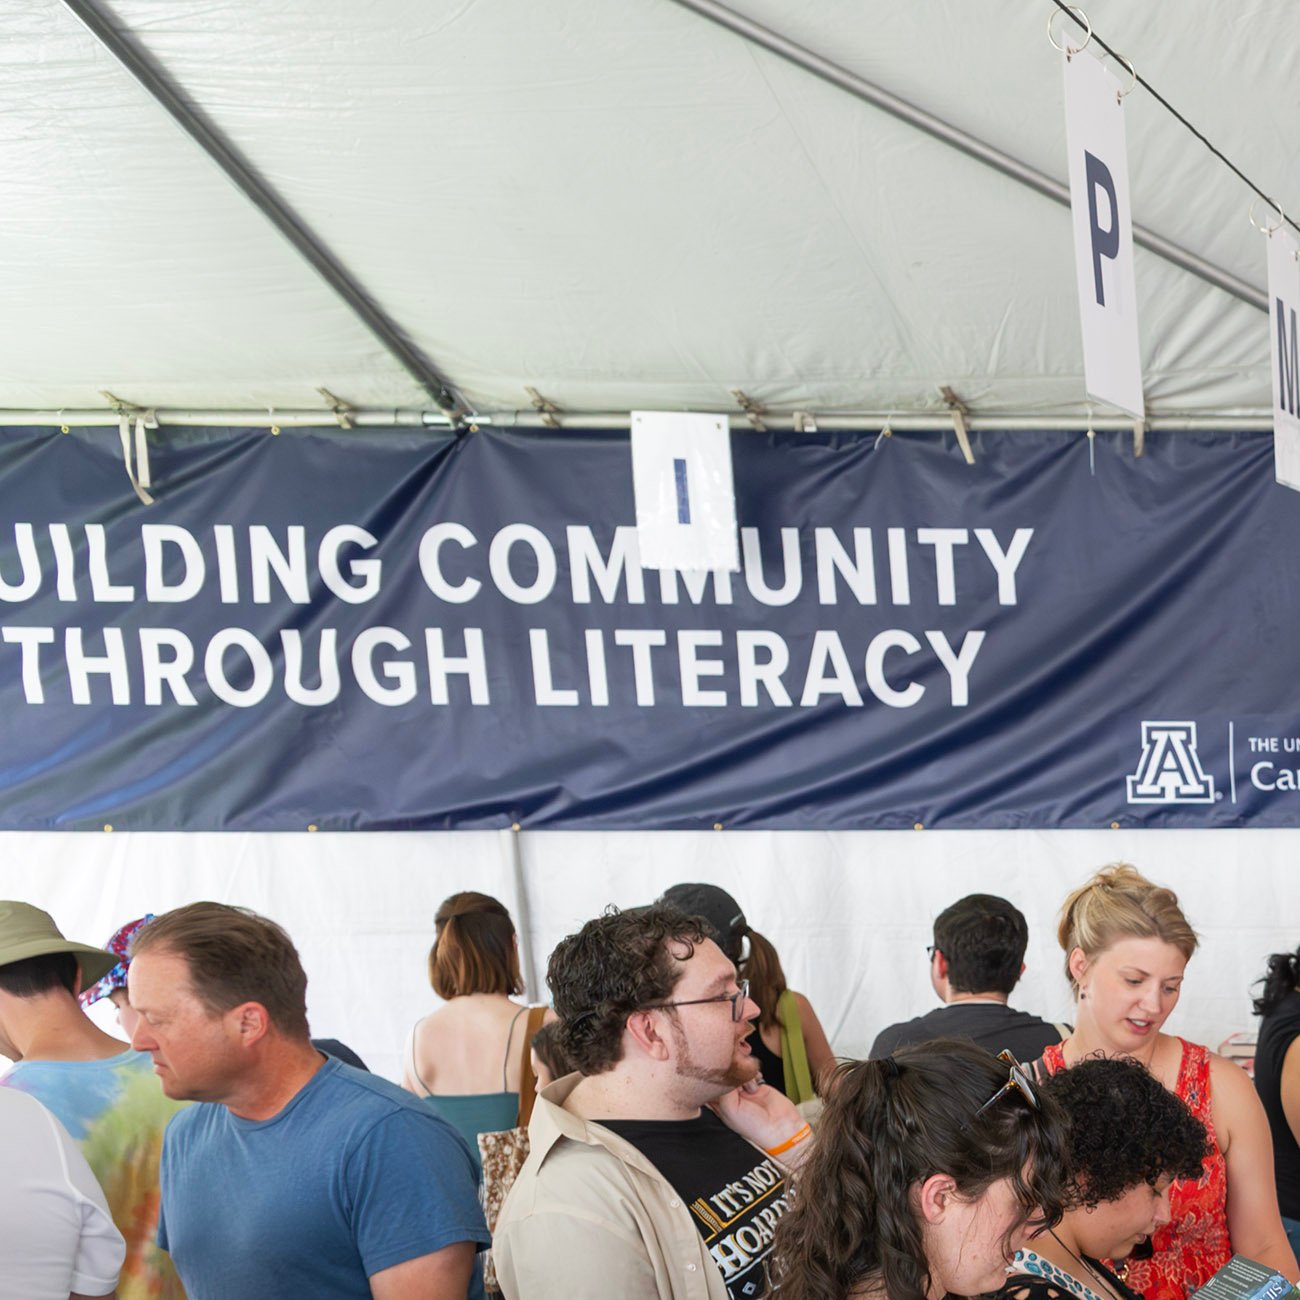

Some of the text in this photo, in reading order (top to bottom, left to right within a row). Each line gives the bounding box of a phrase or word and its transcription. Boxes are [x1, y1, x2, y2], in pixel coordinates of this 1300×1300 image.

[1085, 149, 1120, 307] P
[1276, 297, 1300, 420] M
[674, 458, 691, 524] I
[2, 626, 986, 708] THROUGH LITERACY
[1248, 737, 1279, 752] THE
[710, 1159, 782, 1218] IT'S NOT
